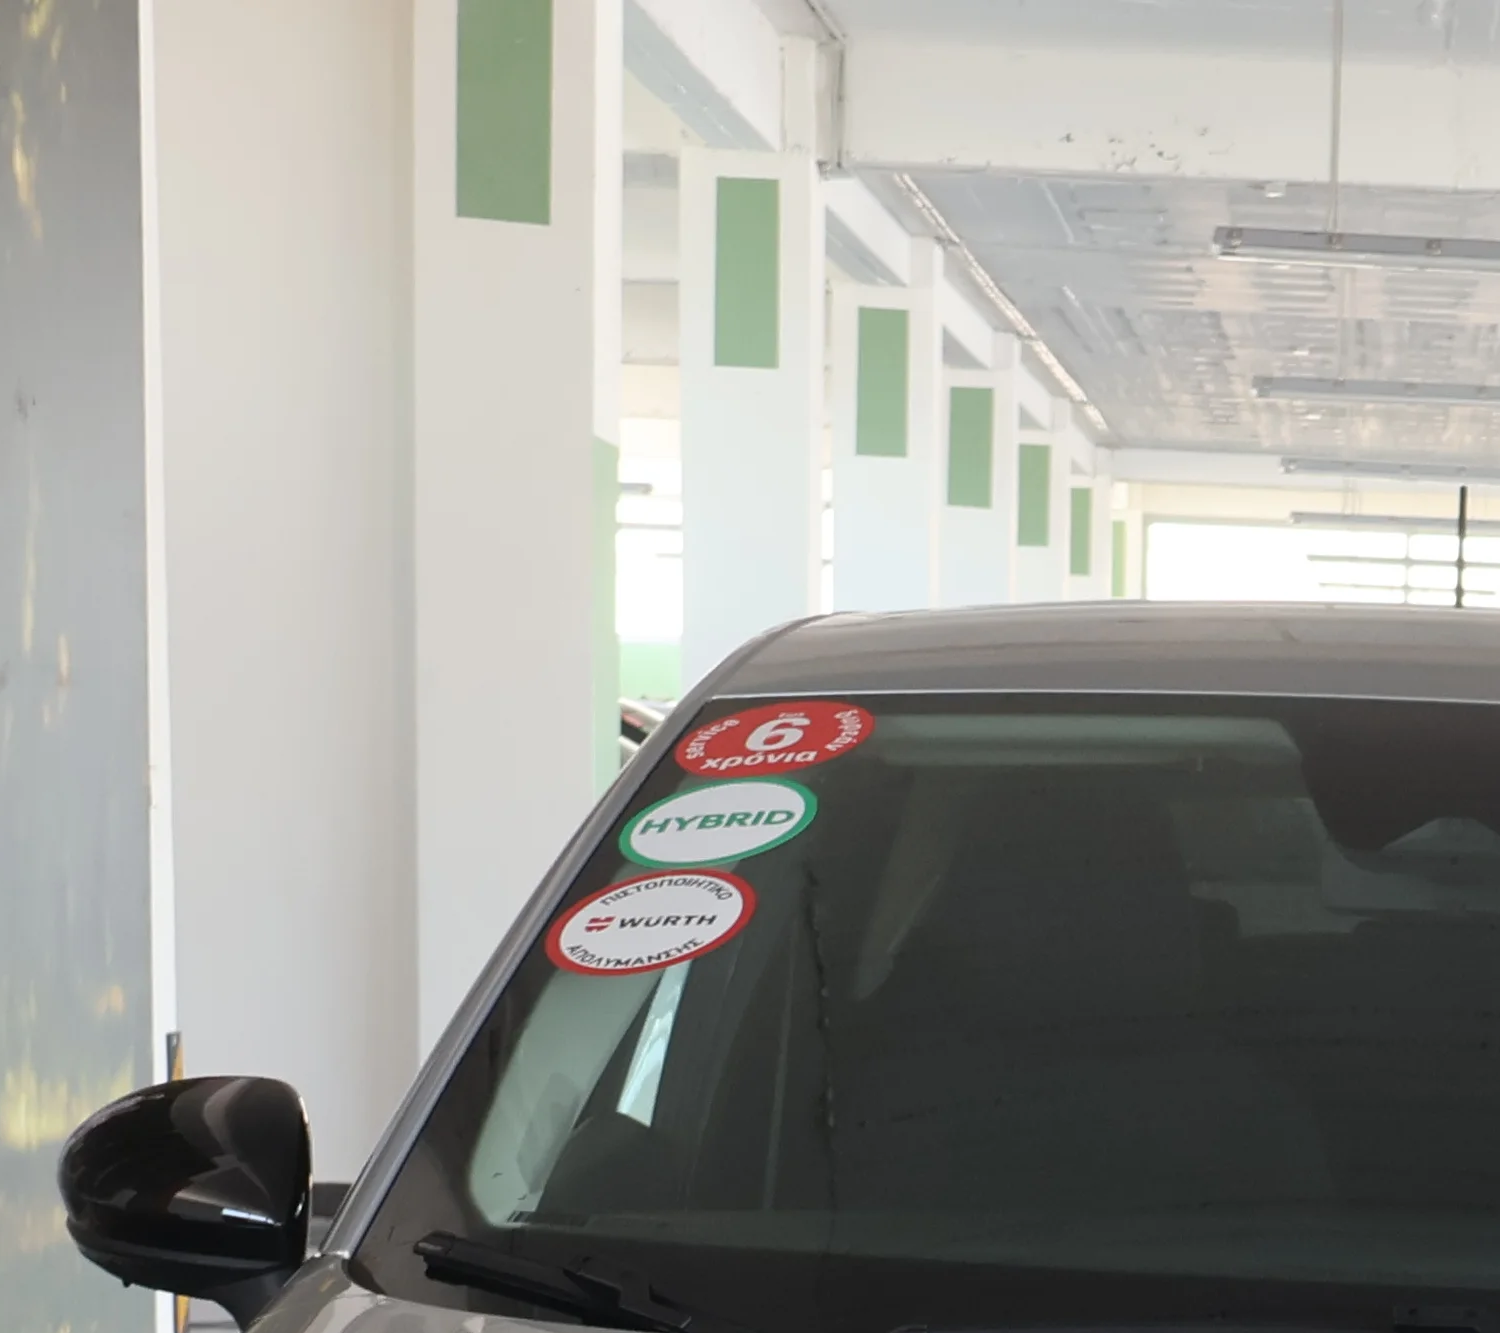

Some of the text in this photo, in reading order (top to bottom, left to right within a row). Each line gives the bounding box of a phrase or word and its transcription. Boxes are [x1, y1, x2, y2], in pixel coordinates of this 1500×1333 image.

[686, 719, 740, 760] service
[745, 717, 811, 751] 6
[701, 750, 817, 770] χρόνια
[640, 810, 796, 835] HYBRID
[600, 877, 733, 906] ΠΙΣΤΟΠΟΙΗΤΙΚΟ
[566, 937, 704, 968] ΑΠΟΛΥΜΑΝΣΗΣ
